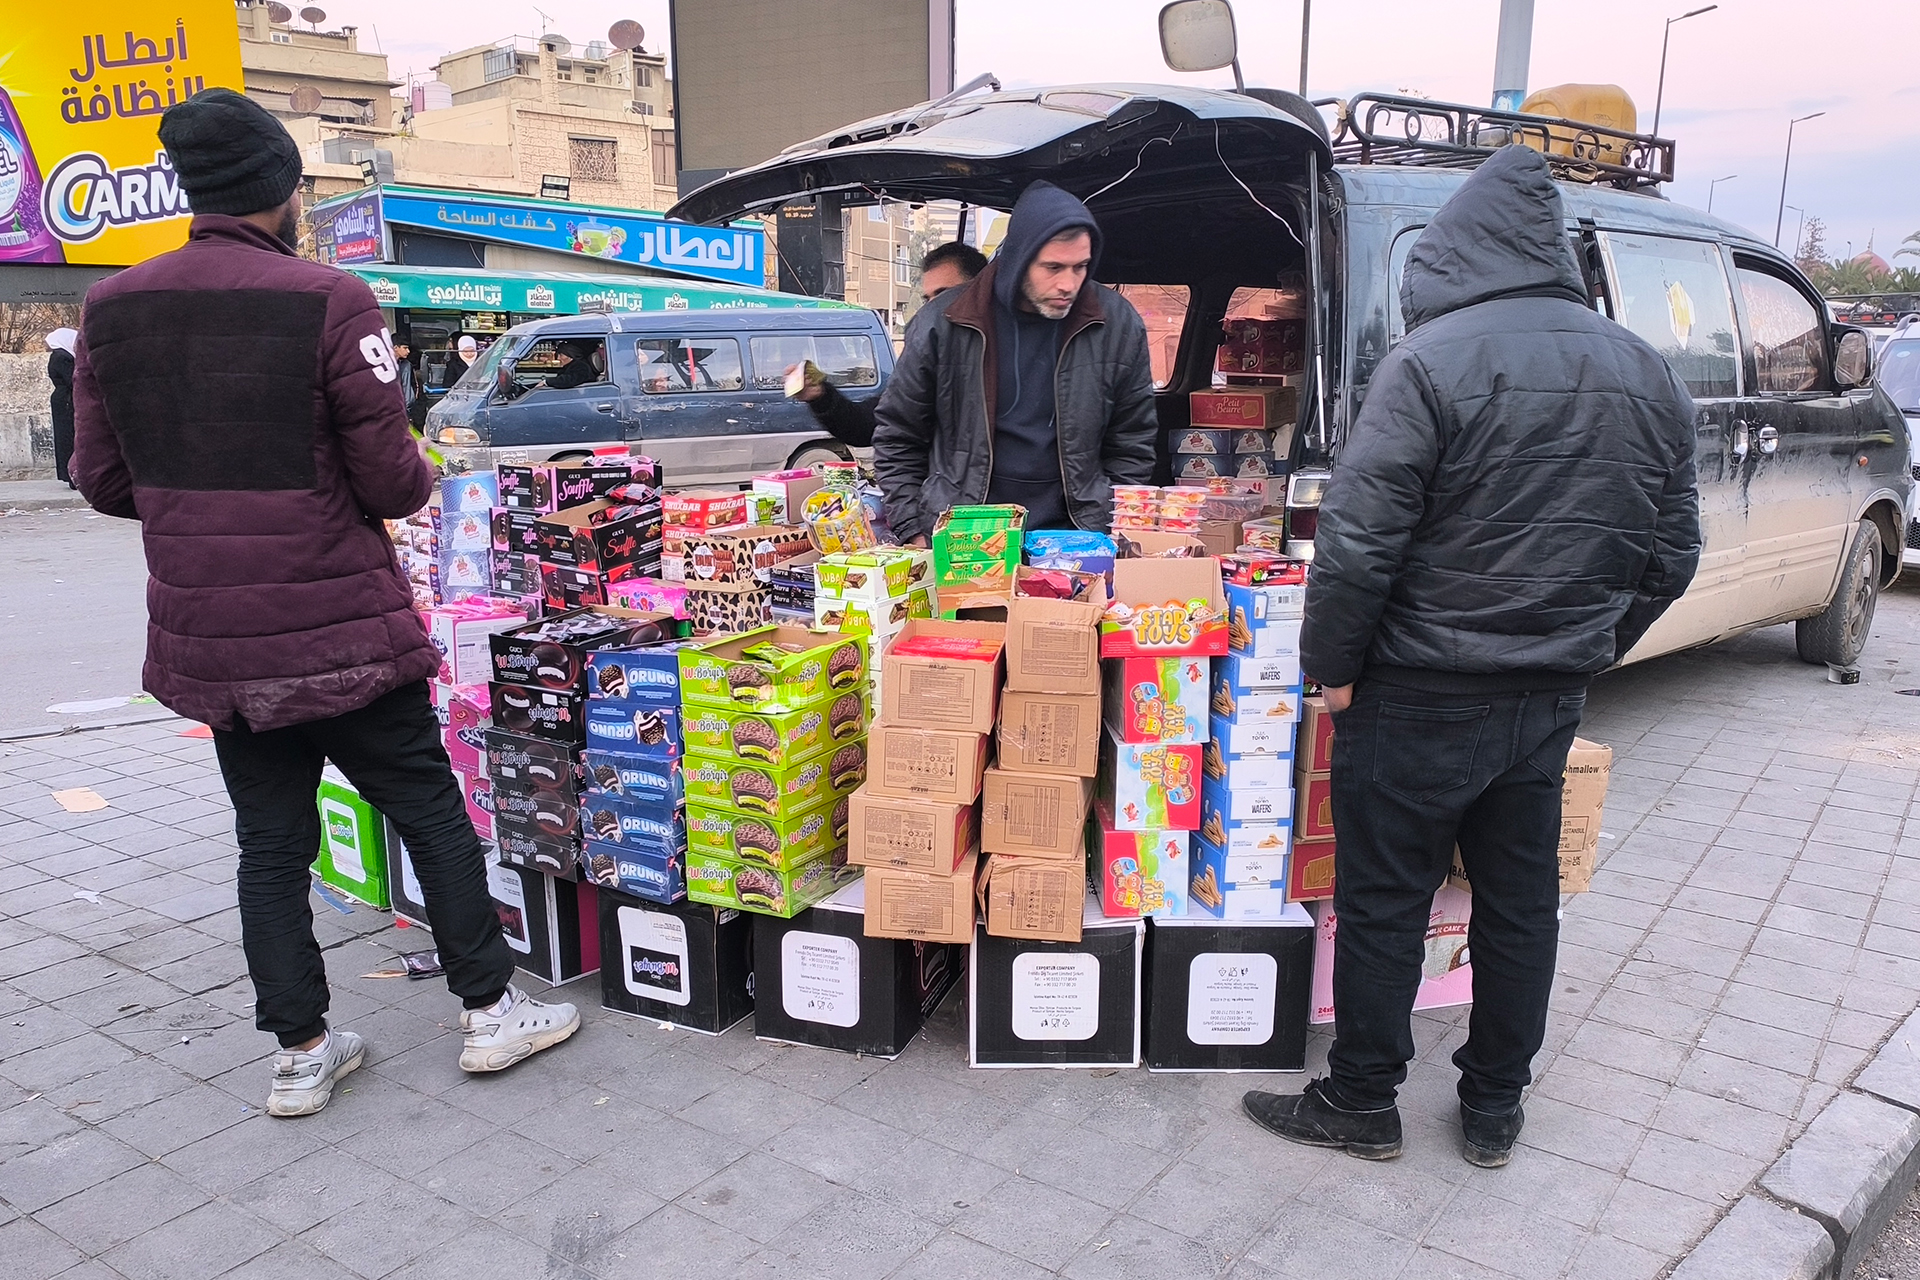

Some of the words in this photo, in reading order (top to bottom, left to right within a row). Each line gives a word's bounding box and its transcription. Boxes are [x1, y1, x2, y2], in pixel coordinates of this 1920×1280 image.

[69, 17, 189, 83] أبطال
[43, 153, 193, 242] CARM
[437, 206, 496, 225] الساحة
[639, 226, 754, 271] العطار
[427, 282, 484, 304] الشامي
[485, 292, 502, 306] بن
[1216, 403, 1242, 414] Beurre
[1222, 397, 1240, 407] Petit
[558, 478, 594, 500] Souffle
[664, 502, 701, 511] SHOXBAR
[708, 497, 745, 511] SHOXBAR
[604, 535, 637, 558] Souffle
[1141, 609, 1186, 626] STAR
[1136, 624, 1191, 644] TOYS
[629, 670, 677, 686] ORUNO
[1260, 671, 1281, 681] WAFERS
[701, 712, 717, 720] GUCI
[1164, 702, 1176, 738] TOYS
[1176, 705, 1186, 734] STAR
[590, 722, 634, 738] ORUNO
[702, 762, 717, 770] GUCI
[1140, 753, 1151, 781] STAR
[1150, 748, 1164, 784] TOYS
[1565, 765, 1599, 773] shmallow
[622, 771, 668, 788] ORUNO
[475, 786, 495, 812] Pink
[705, 812, 720, 820] GUCI
[1251, 804, 1272, 814] WAFERS
[623, 818, 669, 836] ORUNO
[704, 860, 721, 868] GUCI
[1452, 865, 1468, 880] BAG
[620, 863, 664, 884] ORUNO
[1141, 877, 1154, 912] TOYS
[1153, 880, 1164, 908] STAR
[1426, 927, 1442, 936] MILK
[1443, 925, 1461, 933] CAKE
